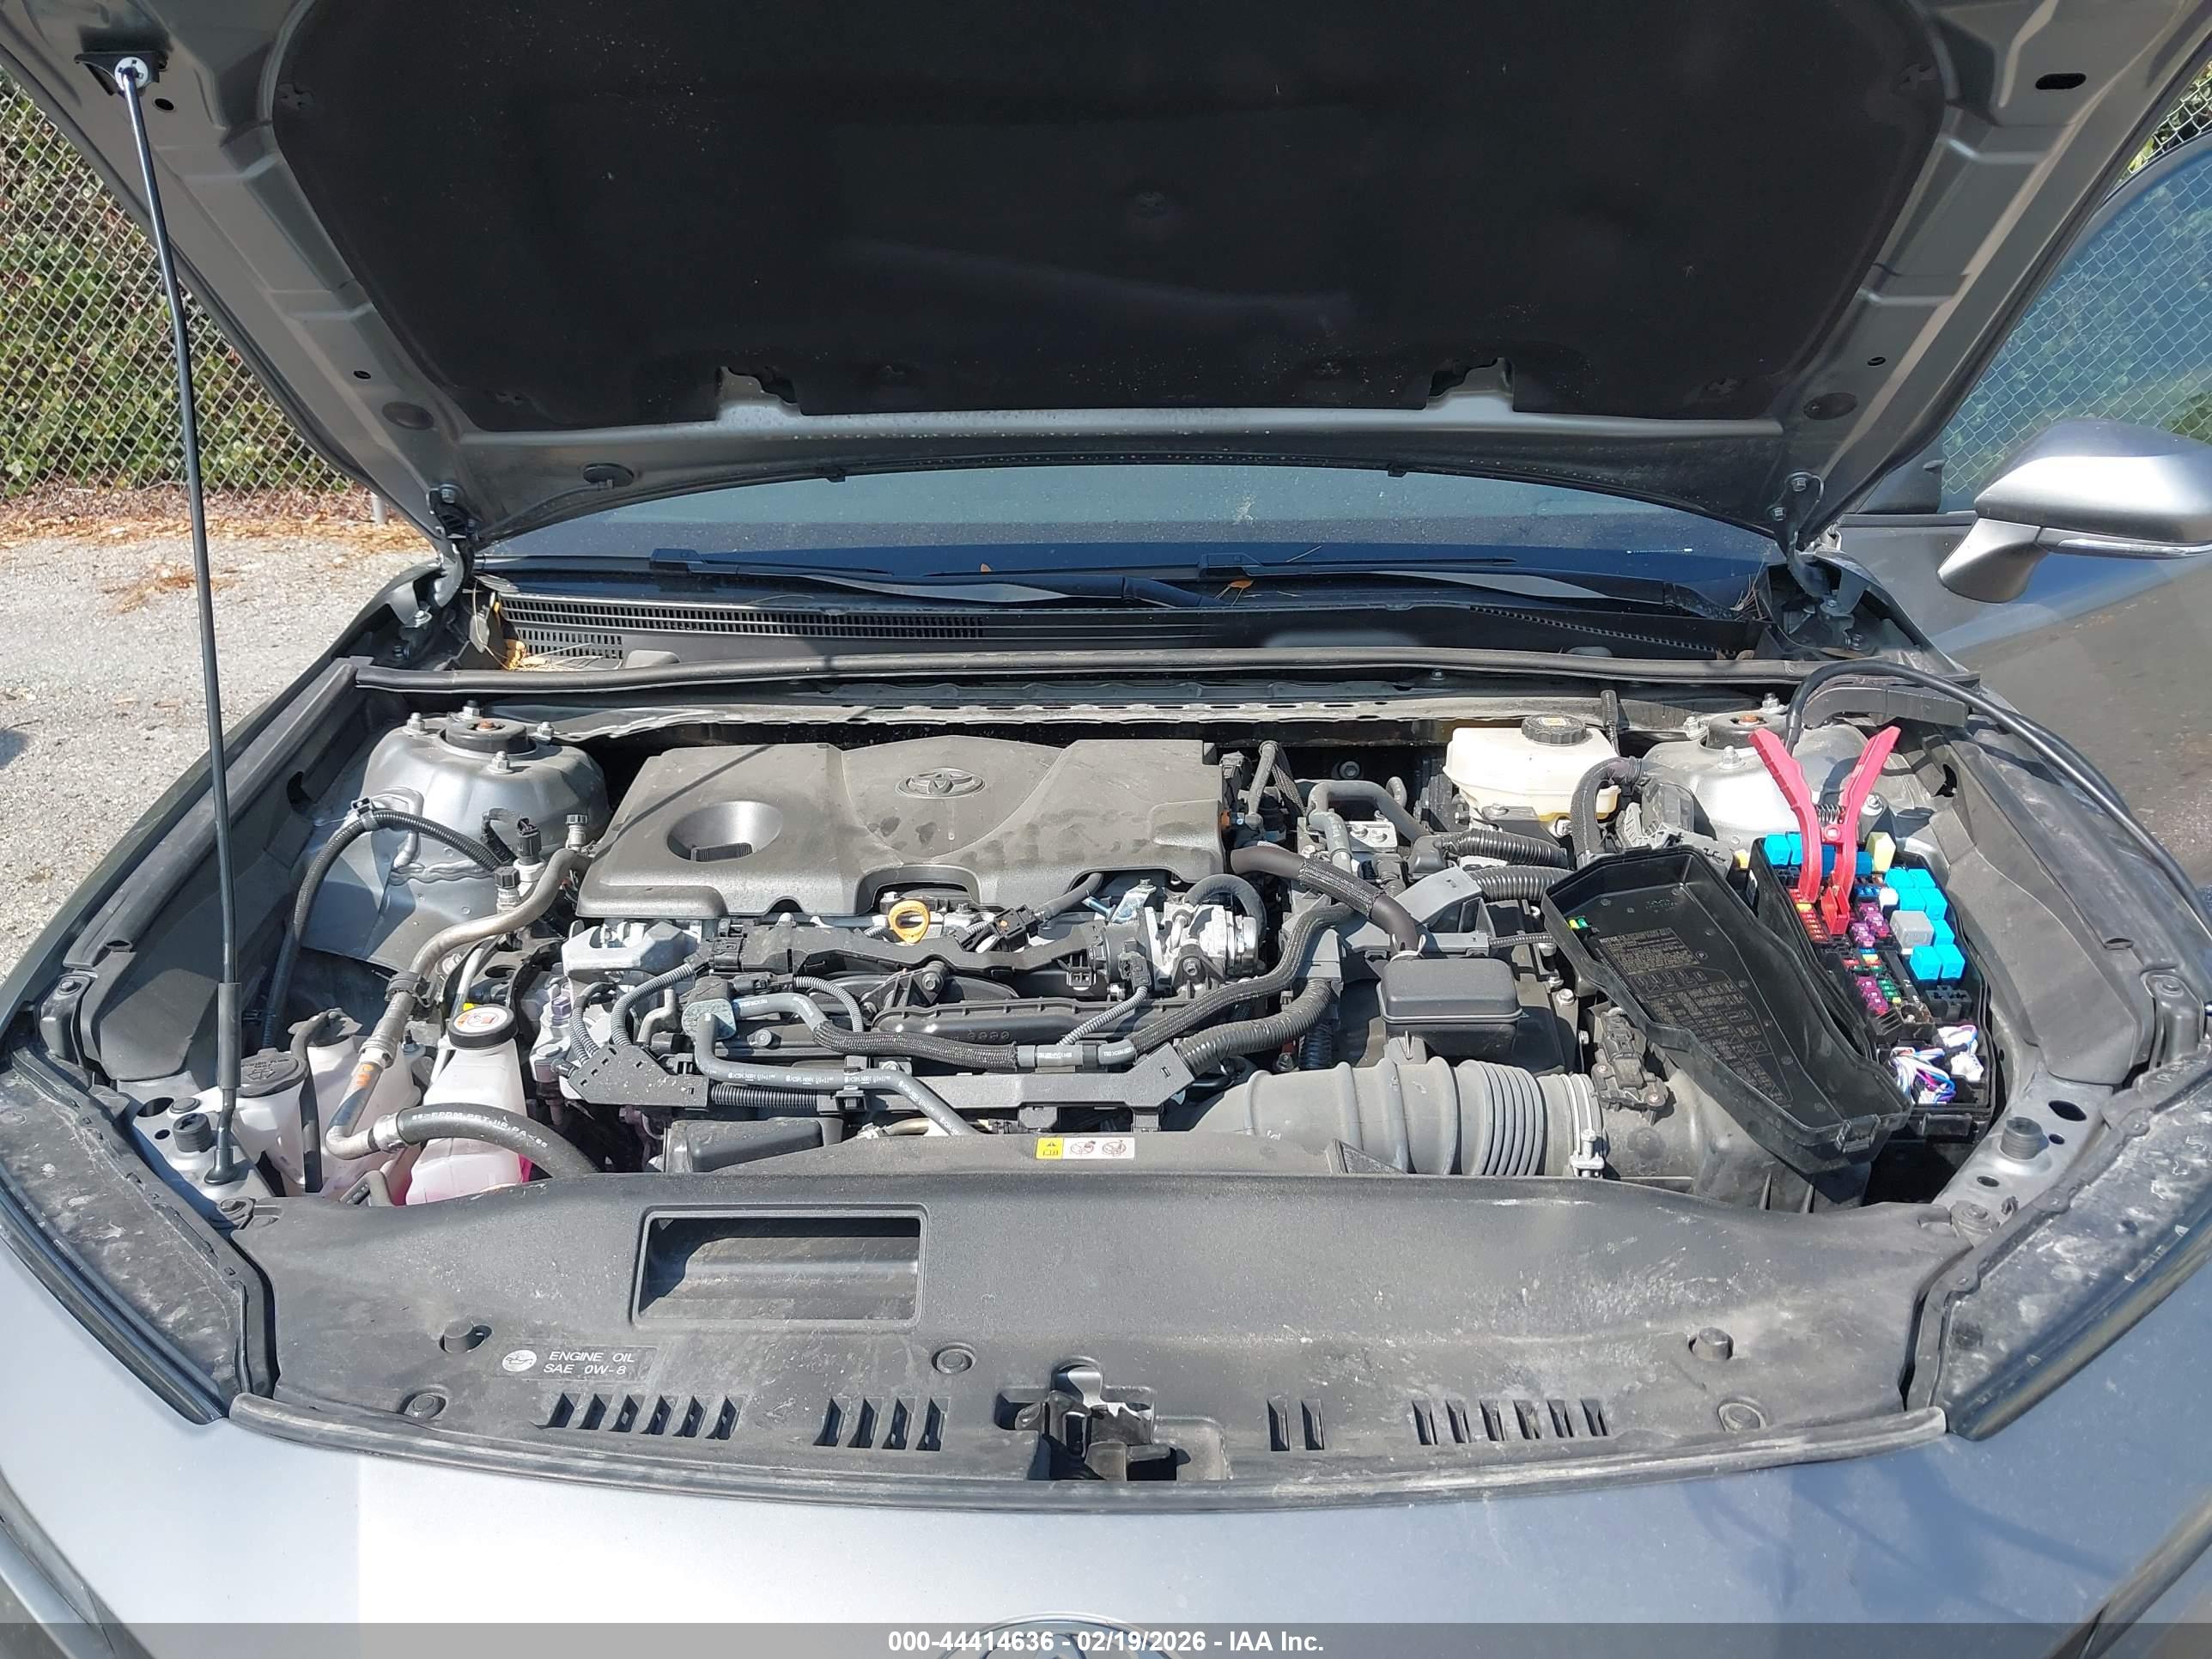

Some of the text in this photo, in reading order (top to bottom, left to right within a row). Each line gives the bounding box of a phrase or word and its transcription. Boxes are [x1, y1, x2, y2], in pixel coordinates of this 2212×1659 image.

[549, 1351, 635, 1363] ENGINE OIL
[543, 1363, 627, 1375] SAE 0W-8
